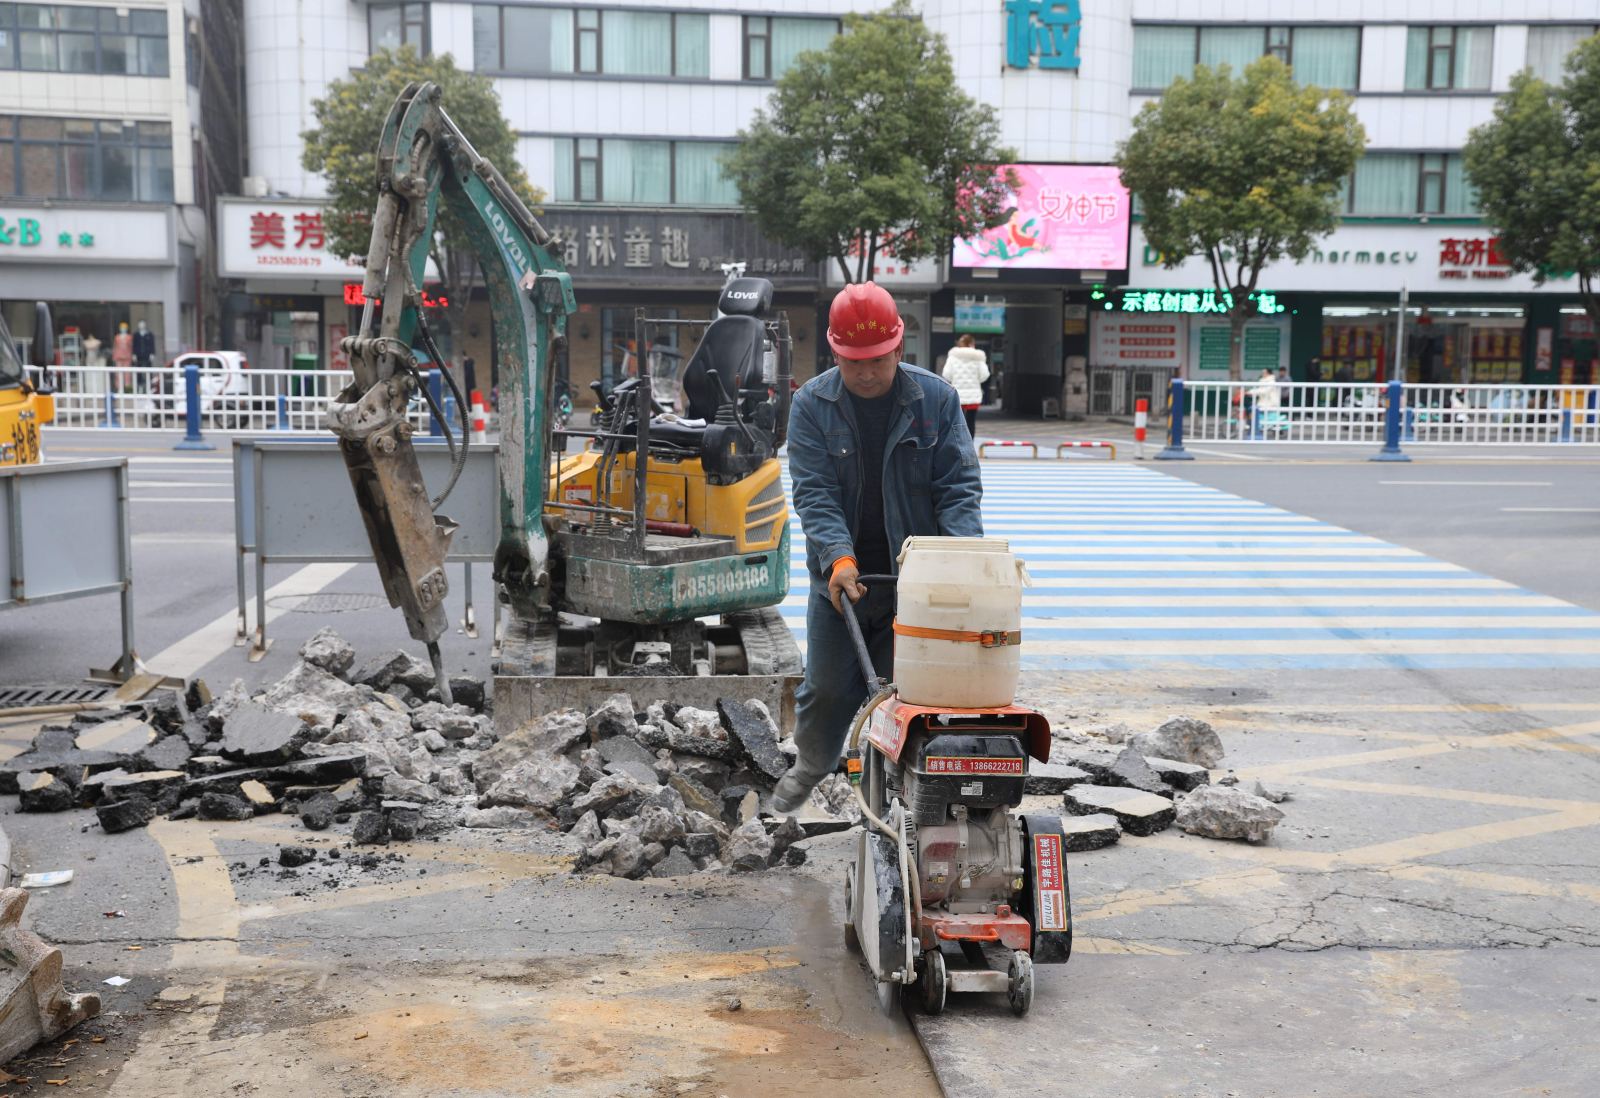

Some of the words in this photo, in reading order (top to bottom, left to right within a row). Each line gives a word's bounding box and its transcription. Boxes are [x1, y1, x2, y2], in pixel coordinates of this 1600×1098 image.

[1040, 190, 1116, 222] 女神节
[485, 200, 529, 272] LOVOL
[1311, 249, 1418, 264] harmacy
[969, 761, 1021, 771] 13866222718
